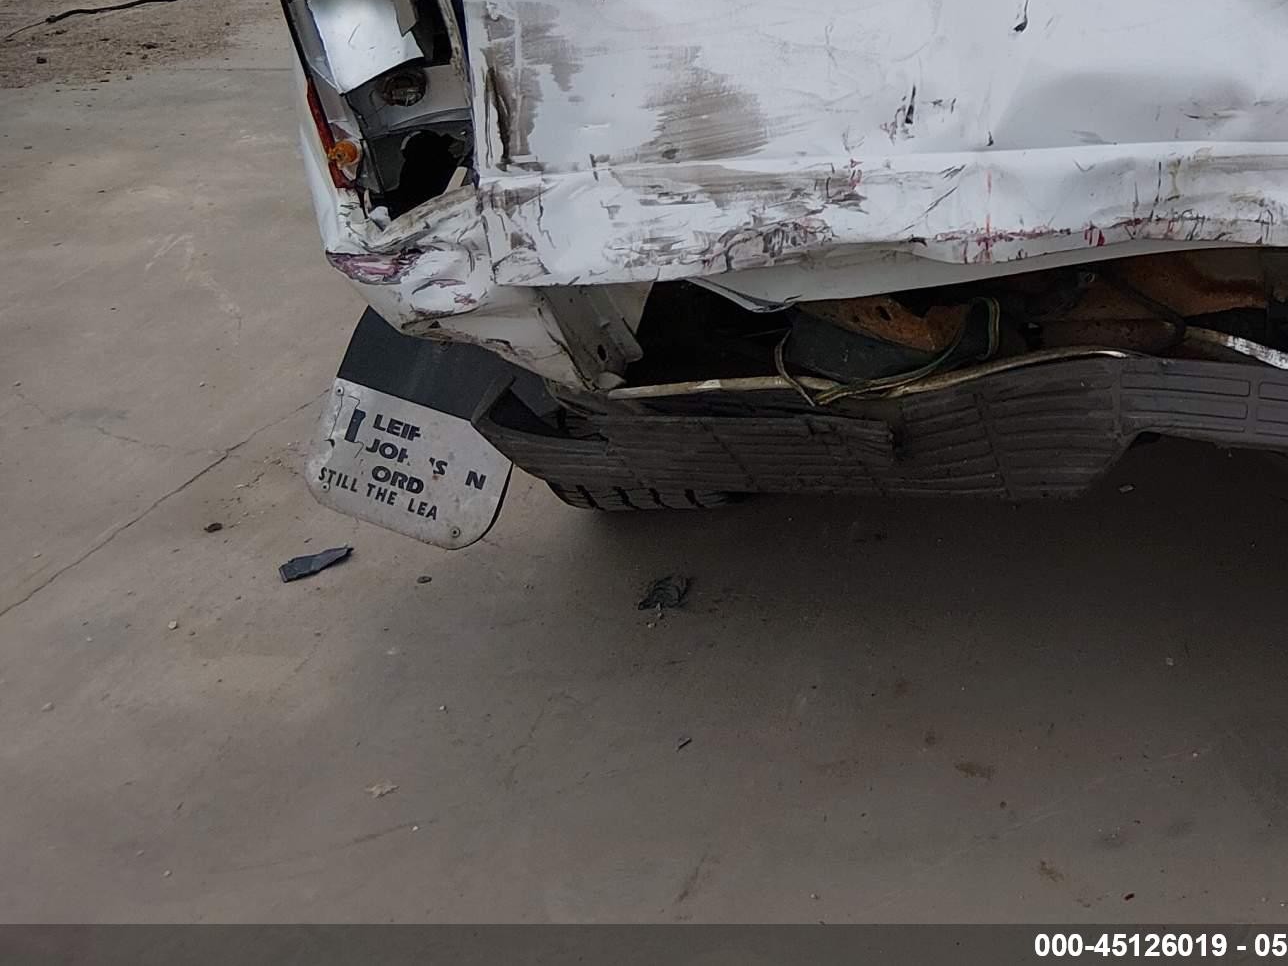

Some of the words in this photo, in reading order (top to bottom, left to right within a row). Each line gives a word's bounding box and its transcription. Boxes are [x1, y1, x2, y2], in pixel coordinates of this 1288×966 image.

[372, 413, 422, 442] LEIF
[318, 466, 358, 493] STILL
[366, 482, 398, 507] THE
[371, 465, 425, 495] ORD
